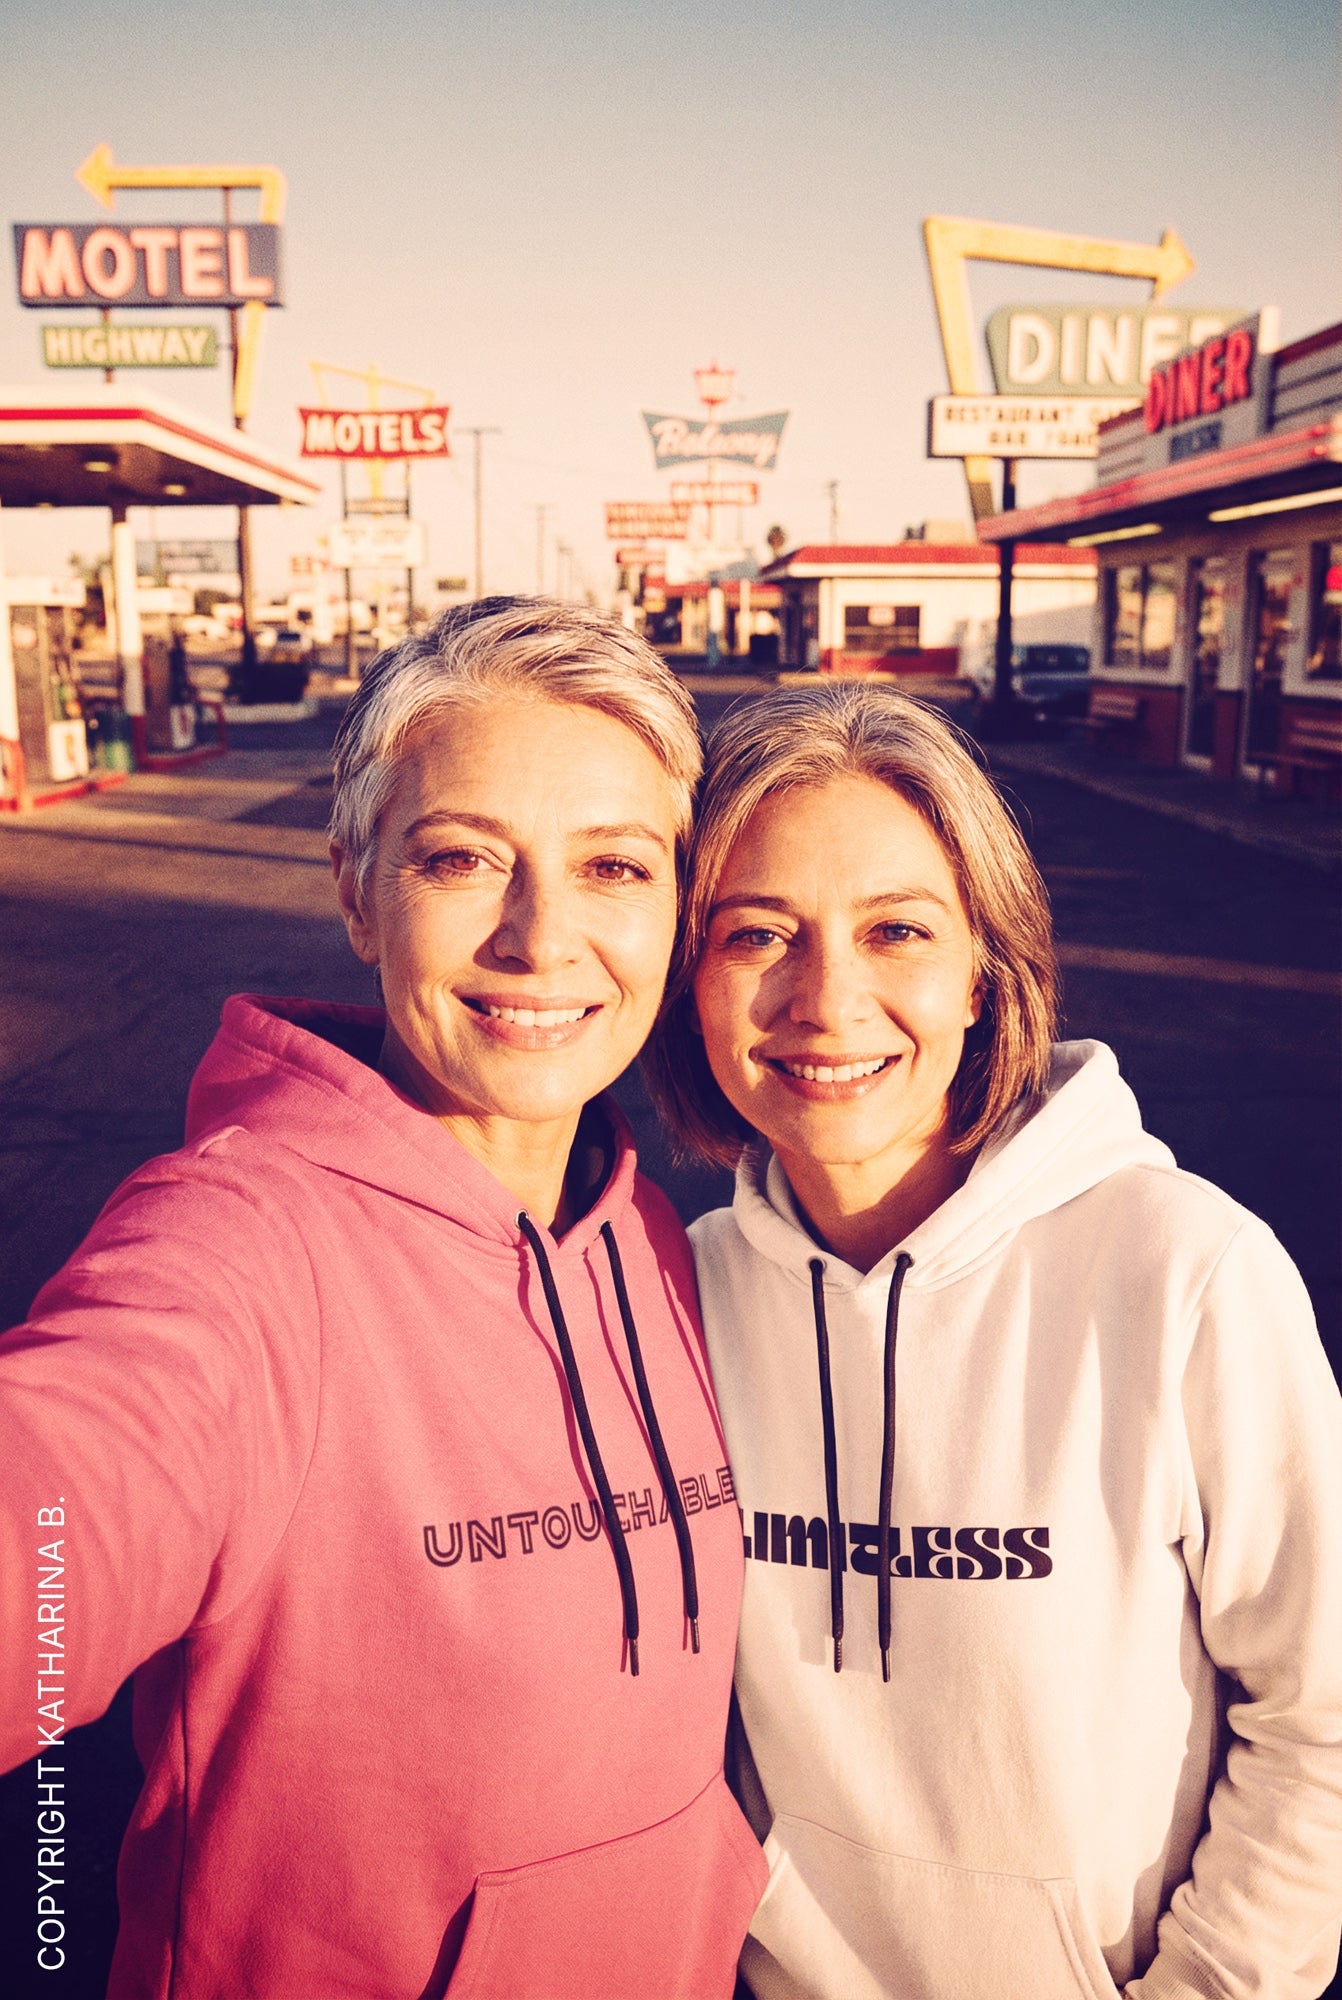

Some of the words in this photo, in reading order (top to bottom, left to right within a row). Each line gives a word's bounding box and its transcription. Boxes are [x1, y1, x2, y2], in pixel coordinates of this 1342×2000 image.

[20, 227, 274, 298] MOTEL
[45, 327, 210, 365] HIGHWAY
[1007, 313, 1224, 386] DINE
[1143, 330, 1252, 434] DINER
[305, 411, 446, 454] MOTELS
